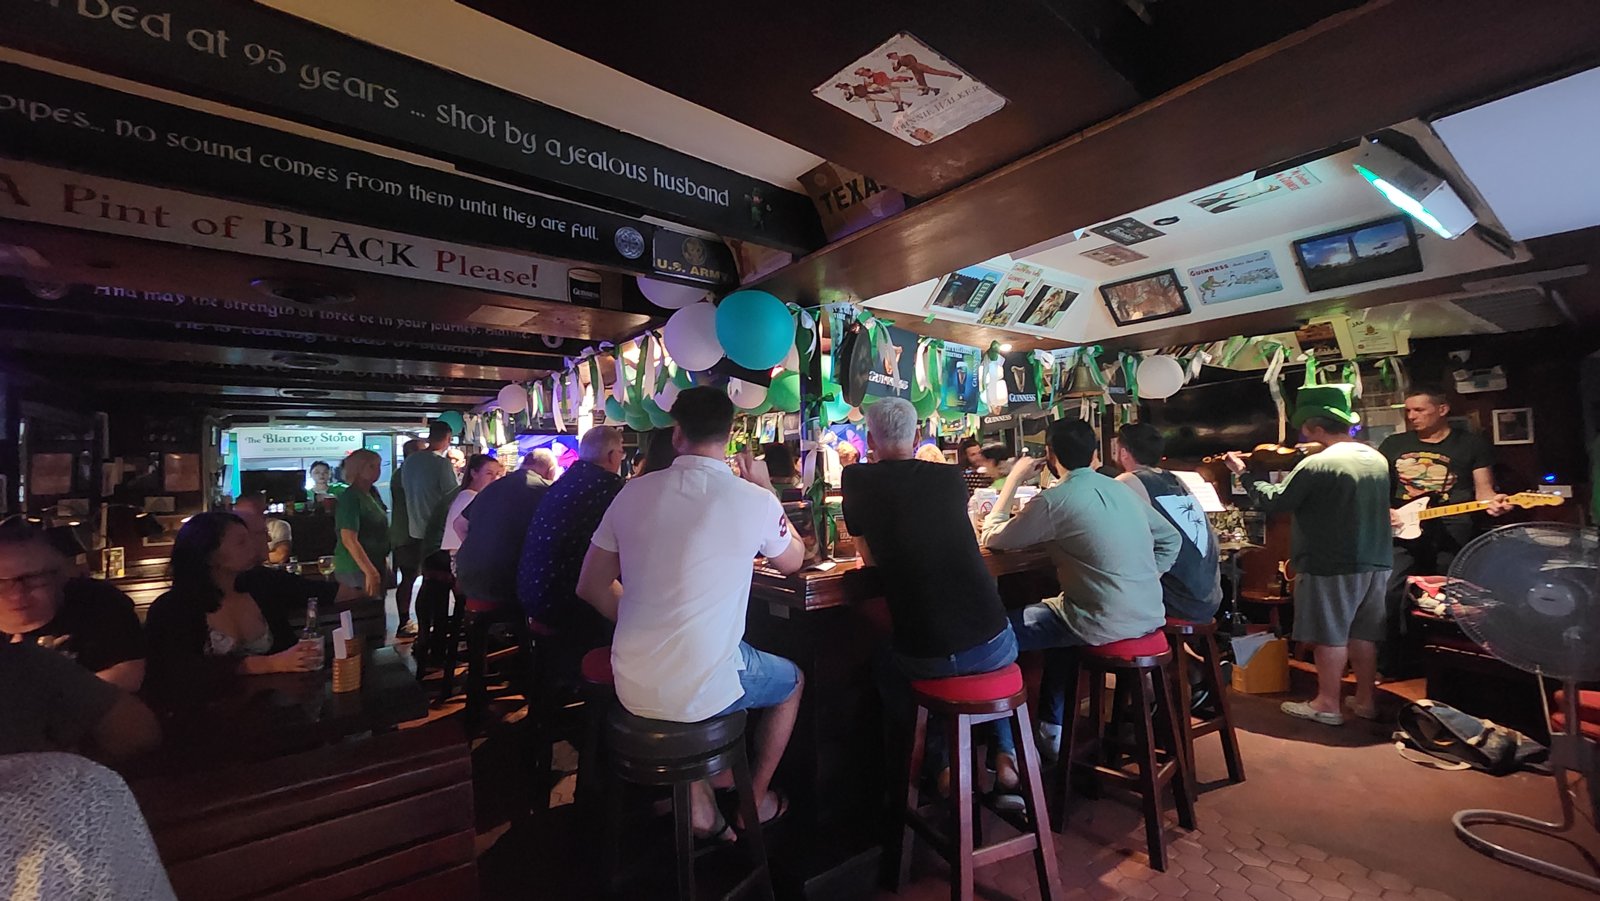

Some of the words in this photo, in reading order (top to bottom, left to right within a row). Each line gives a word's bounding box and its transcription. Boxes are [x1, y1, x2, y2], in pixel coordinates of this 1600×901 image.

[186, 28, 230, 59] at
[243, 43, 287, 75] 95
[299, 63, 400, 109] years
[436, 104, 497, 139] shot
[504, 120, 537, 154] by
[545, 138, 561, 158] a
[560, 144, 649, 183] jealous
[653, 167, 730, 207] husband
[114, 119, 157, 142] no
[166, 132, 252, 164] sound
[259, 153, 339, 183] comes
[346, 171, 403, 198] from
[408, 183, 455, 208] them
[460, 197, 498, 218] until
[502, 205, 537, 230] they
[541, 217, 567, 234] are
[571, 223, 600, 242] full.
[821, 175, 888, 215] TEXA
[63, 183, 172, 229] Pint
[191, 213, 244, 240] of
[263, 218, 421, 270] BLACK
[434, 249, 540, 289] Please!
[656, 258, 687, 274] U.S.
[1190, 263, 1230, 277] GUINNESS
[396, 318, 428, 330] your
[1008, 393, 1037, 403] GUINNESS
[983, 414, 1013, 424] GUINNESS
[245, 436, 262, 444] The
[262, 433, 318, 446] Blarney
[320, 432, 356, 443] Stone
